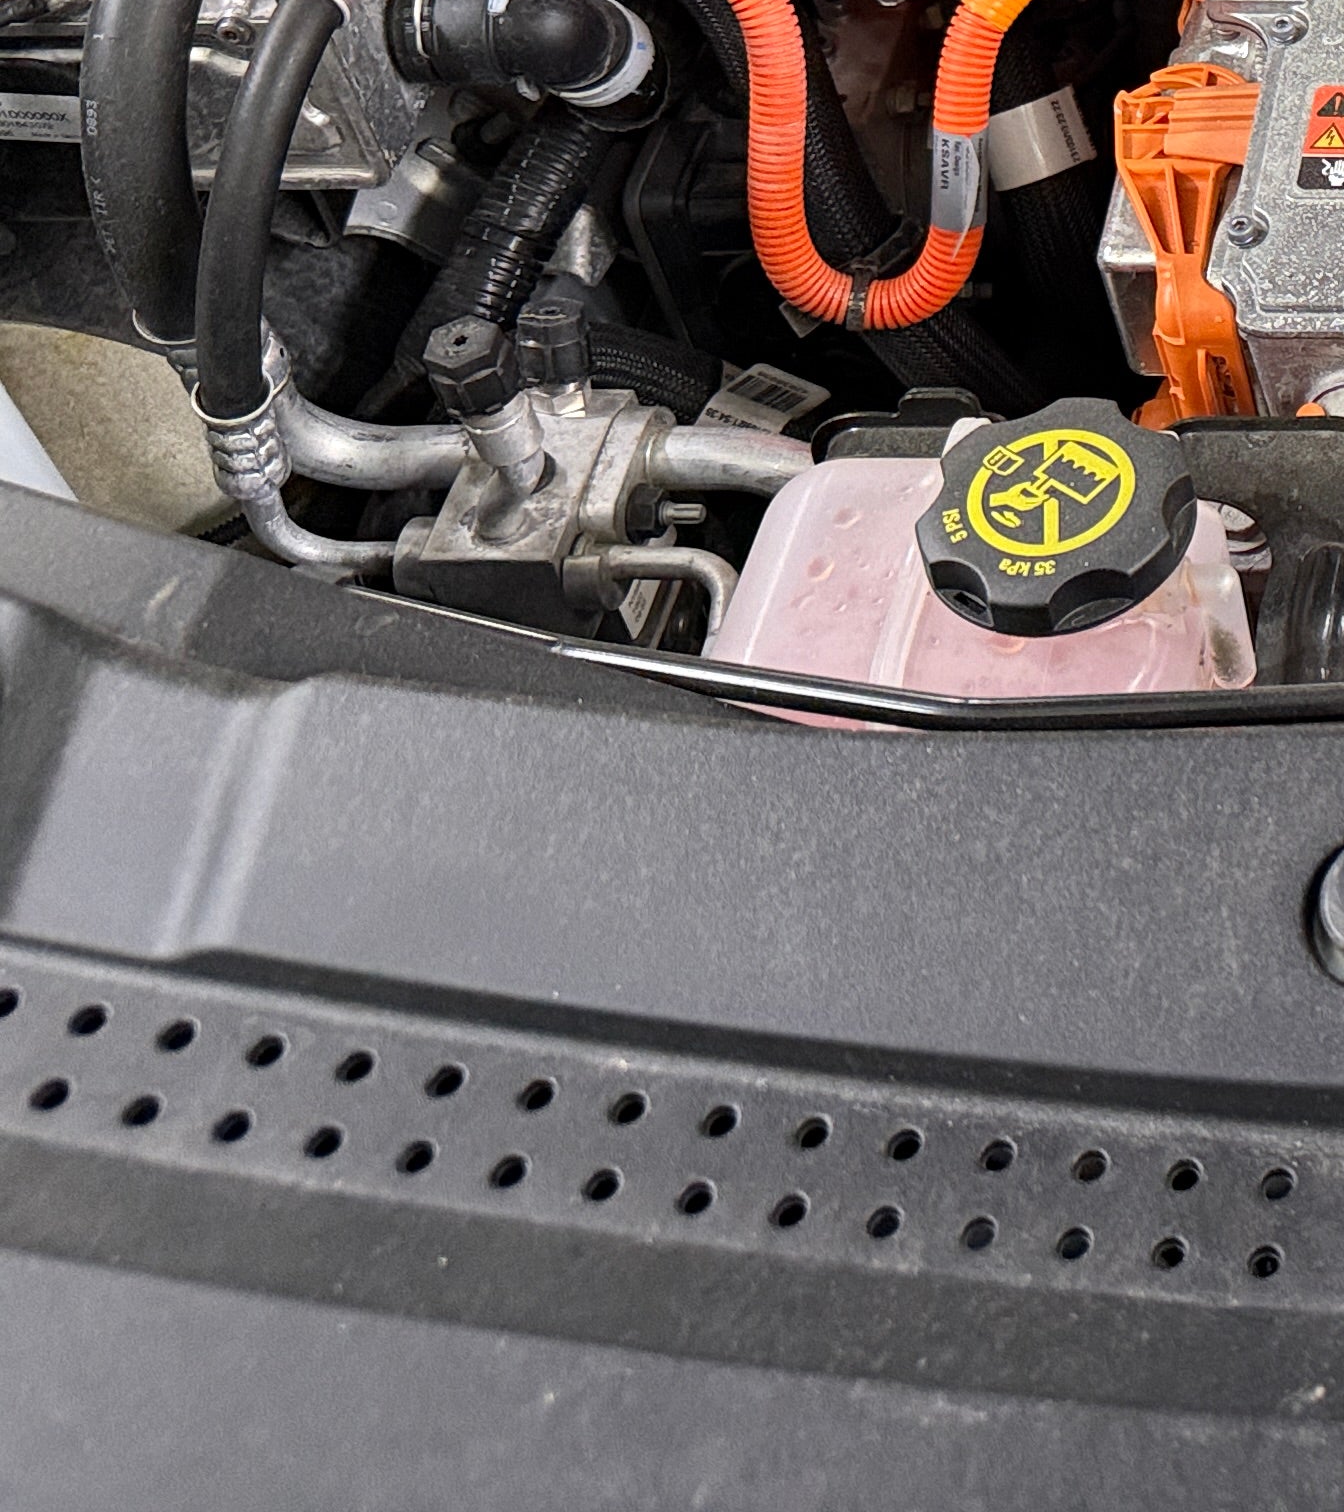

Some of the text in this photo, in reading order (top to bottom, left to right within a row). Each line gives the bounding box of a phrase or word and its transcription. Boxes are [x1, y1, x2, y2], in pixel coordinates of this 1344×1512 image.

[942, 508, 968, 544] 5 PSI
[998, 558, 1056, 577] 35 kPa
